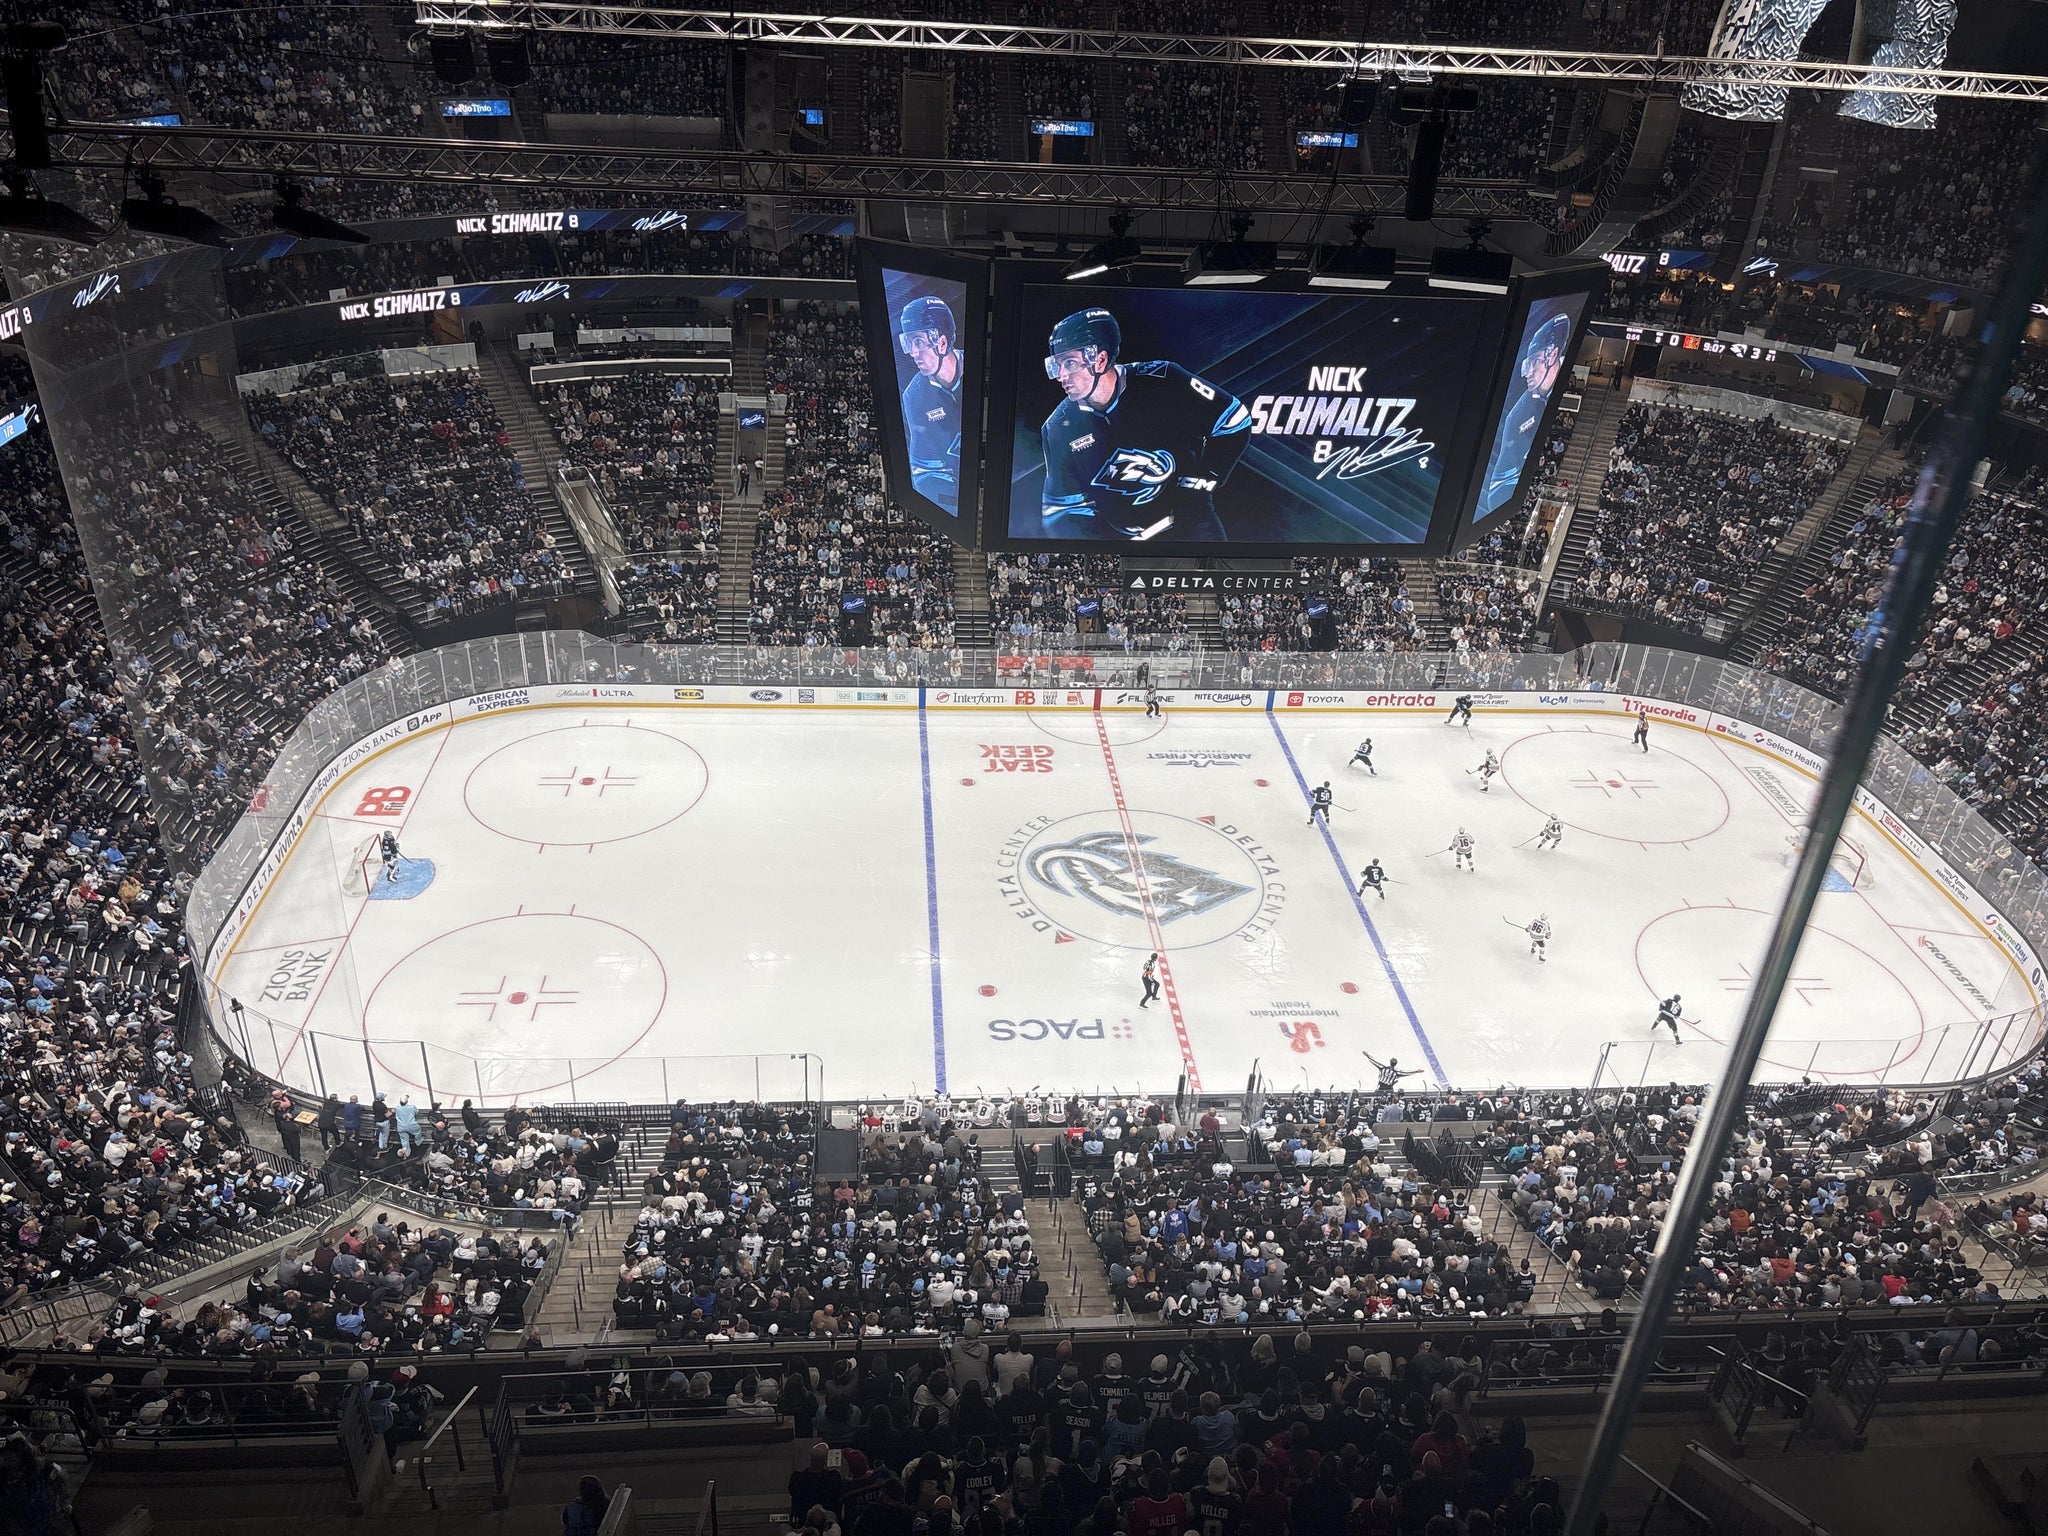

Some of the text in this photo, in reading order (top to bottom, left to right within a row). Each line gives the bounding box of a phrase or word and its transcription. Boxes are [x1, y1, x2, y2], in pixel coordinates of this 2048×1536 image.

[456, 212, 579, 234] NICK SCHMALTZ 8
[1659, 252, 1670, 266] 8
[340, 290, 461, 321] NICK SCHMALTZ 8
[22, 306, 33, 325] 8
[1669, 334, 1680, 346] 0
[1702, 342, 1726, 354] 9:07
[1750, 347, 1761, 360] 3
[1308, 366, 1367, 392] NICK
[1190, 377, 1216, 400] 8
[1250, 395, 1417, 436] SCHMALTZ
[1313, 440, 1333, 463] 8
[1177, 477, 1217, 491] CM
[1152, 577, 1293, 589] DELTA CENTER
[468, 689, 528, 706] AMERICAN
[754, 691, 778, 700] Ford
[953, 692, 1004, 704] Interform
[1366, 693, 1436, 707] entrata
[1539, 696, 1568, 706] VLCM
[477, 697, 530, 712] EXPRESS
[1633, 700, 1697, 723] Trucordia
[341, 726, 403, 769] ZIONS BANK
[978, 744, 1055, 758] GEEK
[1766, 738, 1823, 772] Select Health
[984, 758, 1054, 773] SEAT
[1750, 769, 1801, 814] INGREDIENTS
[1883, 815, 1903, 835] SME
[1459, 838, 1469, 847] 16
[997, 815, 1055, 933] DELTA CENTER
[245, 862, 274, 910] DELTA
[1219, 824, 1285, 944] DELTA CENTER
[1935, 868, 1956, 890] AMERICA
[1953, 886, 1969, 902] FIRST
[259, 950, 304, 1002] ZIONS
[285, 949, 333, 1002] BANK
[1923, 940, 1997, 1011] CROWDSTRIKE
[1271, 1001, 1310, 1010] Health
[1250, 1010, 1339, 1018] Intermountain
[988, 1018, 1106, 1041] PACS
[905, 1106, 917, 1117] 12
[979, 1106, 987, 1116] 8
[1025, 1104, 1038, 1113] 22
[1053, 1103, 1063, 1113] 11
[957, 1120, 970, 1129] 76
